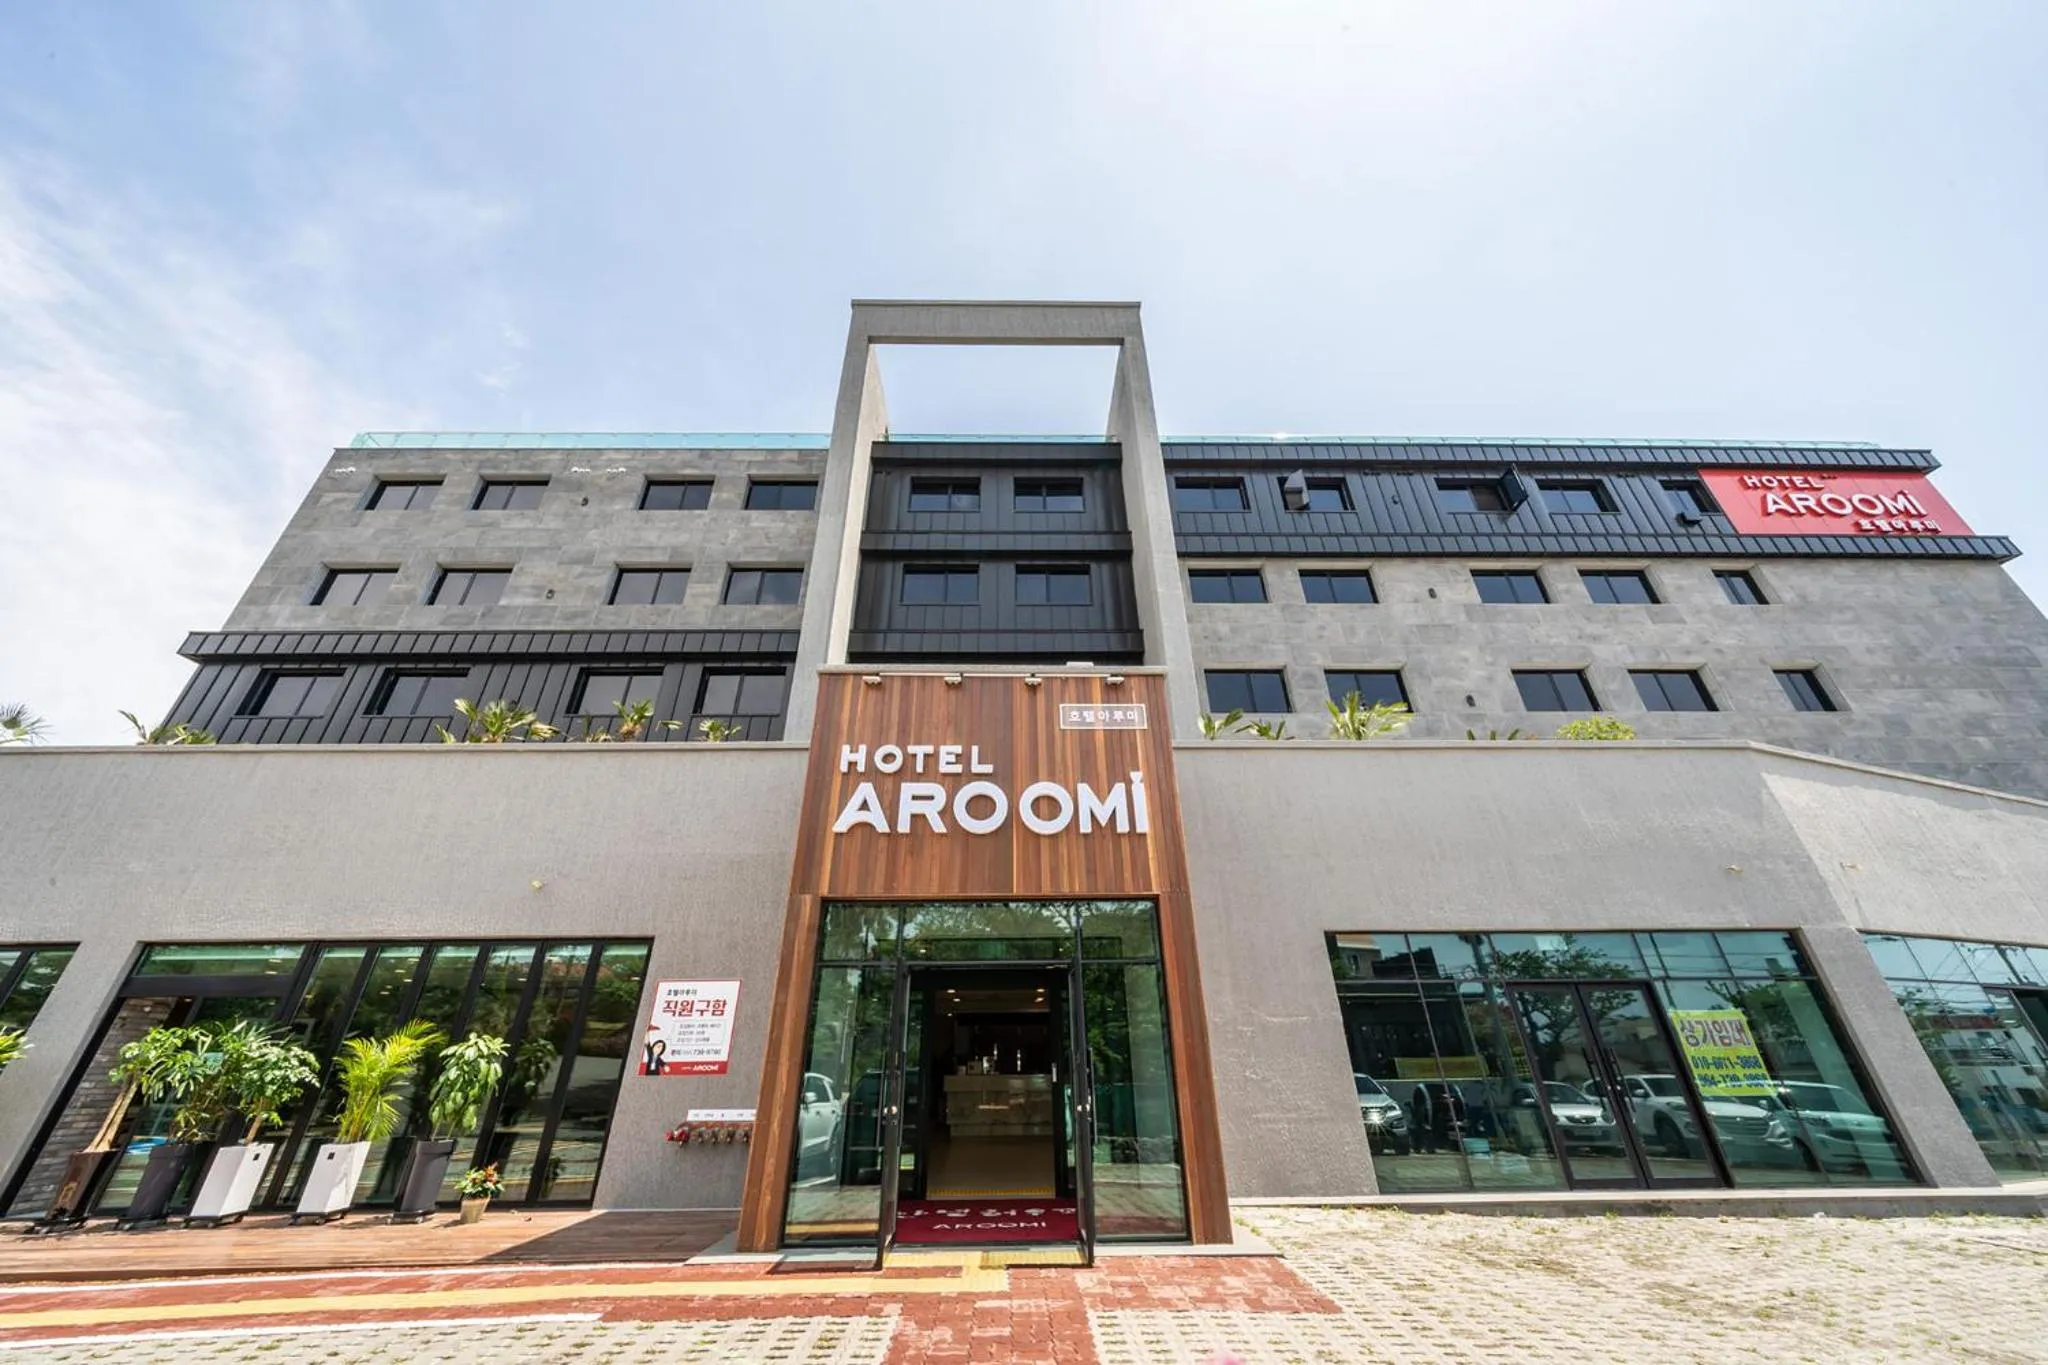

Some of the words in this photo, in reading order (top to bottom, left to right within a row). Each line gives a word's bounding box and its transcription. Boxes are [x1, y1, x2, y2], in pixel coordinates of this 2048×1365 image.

[1742, 474, 1824, 489] HOTEL
[1068, 709, 1138, 723] 호텔아루미
[840, 744, 994, 774] HOTEL
[662, 999, 728, 1017] 직원구함
[1680, 1020, 1752, 1047] 상가임대
